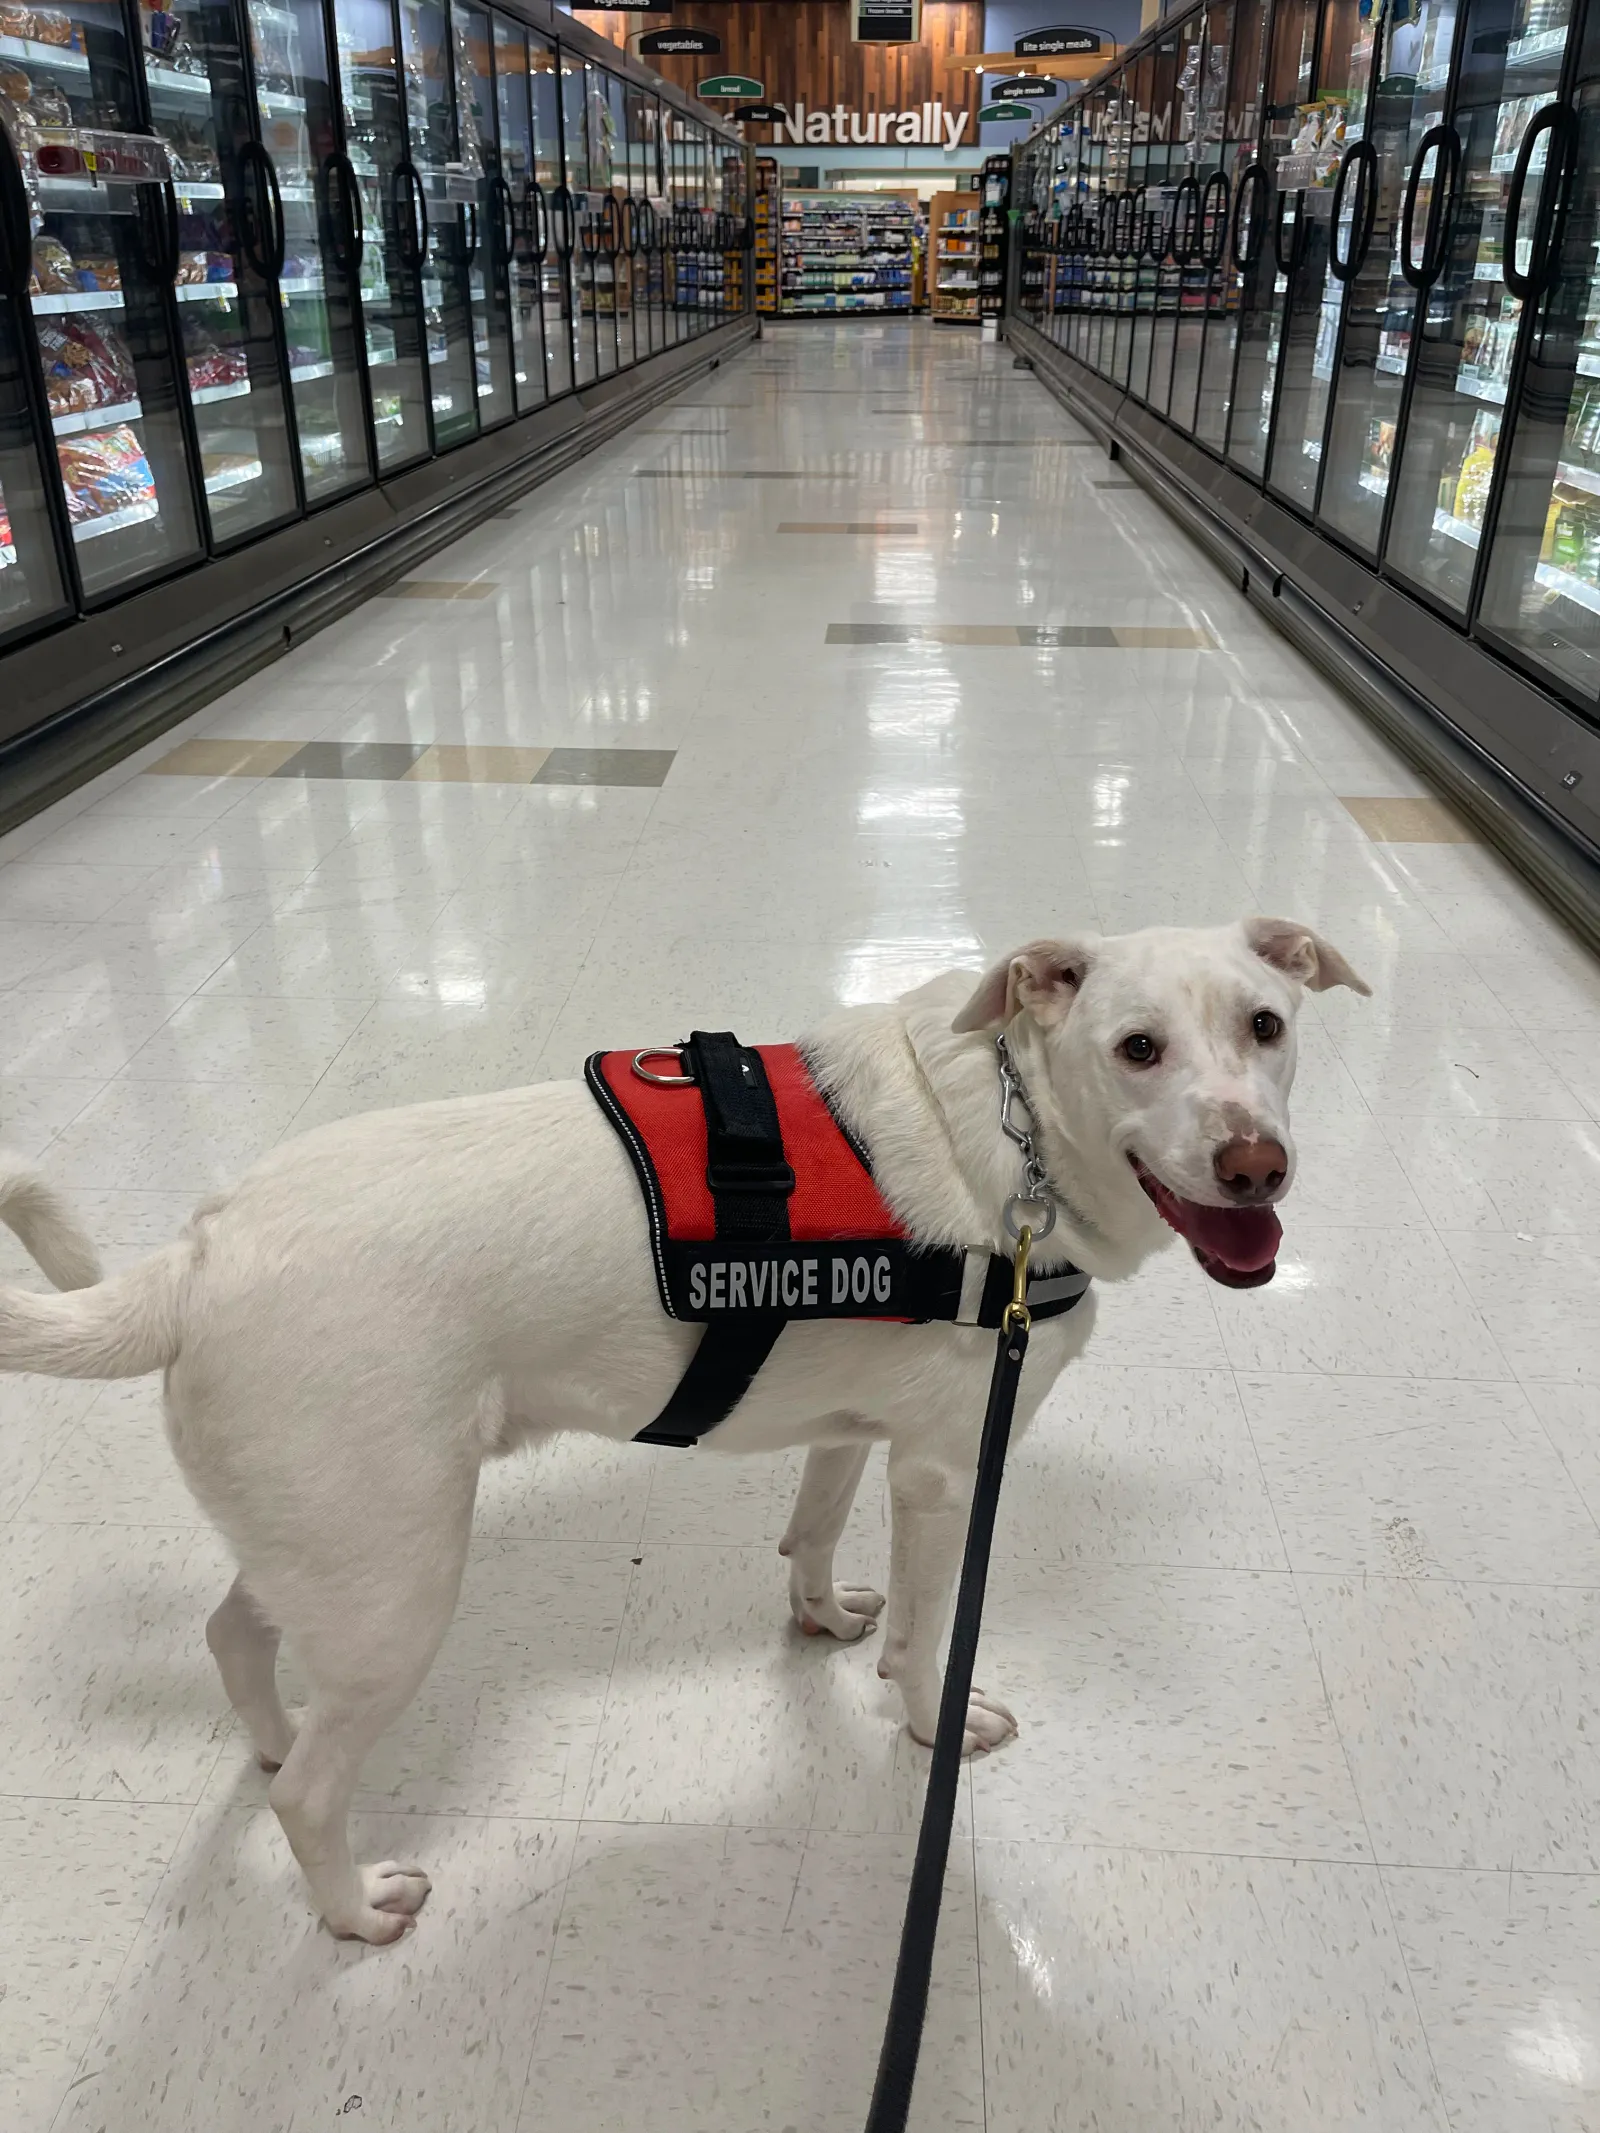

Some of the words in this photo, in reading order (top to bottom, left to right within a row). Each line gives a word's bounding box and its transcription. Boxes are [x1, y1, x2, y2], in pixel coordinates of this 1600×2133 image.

[657, 40, 703, 51] vegetables
[1039, 40, 1064, 52] single
[1066, 38, 1092, 48] meals
[773, 102, 969, 151] Naturally
[689, 1259, 818, 1310] SERVICE
[831, 1255, 891, 1304] DOG
